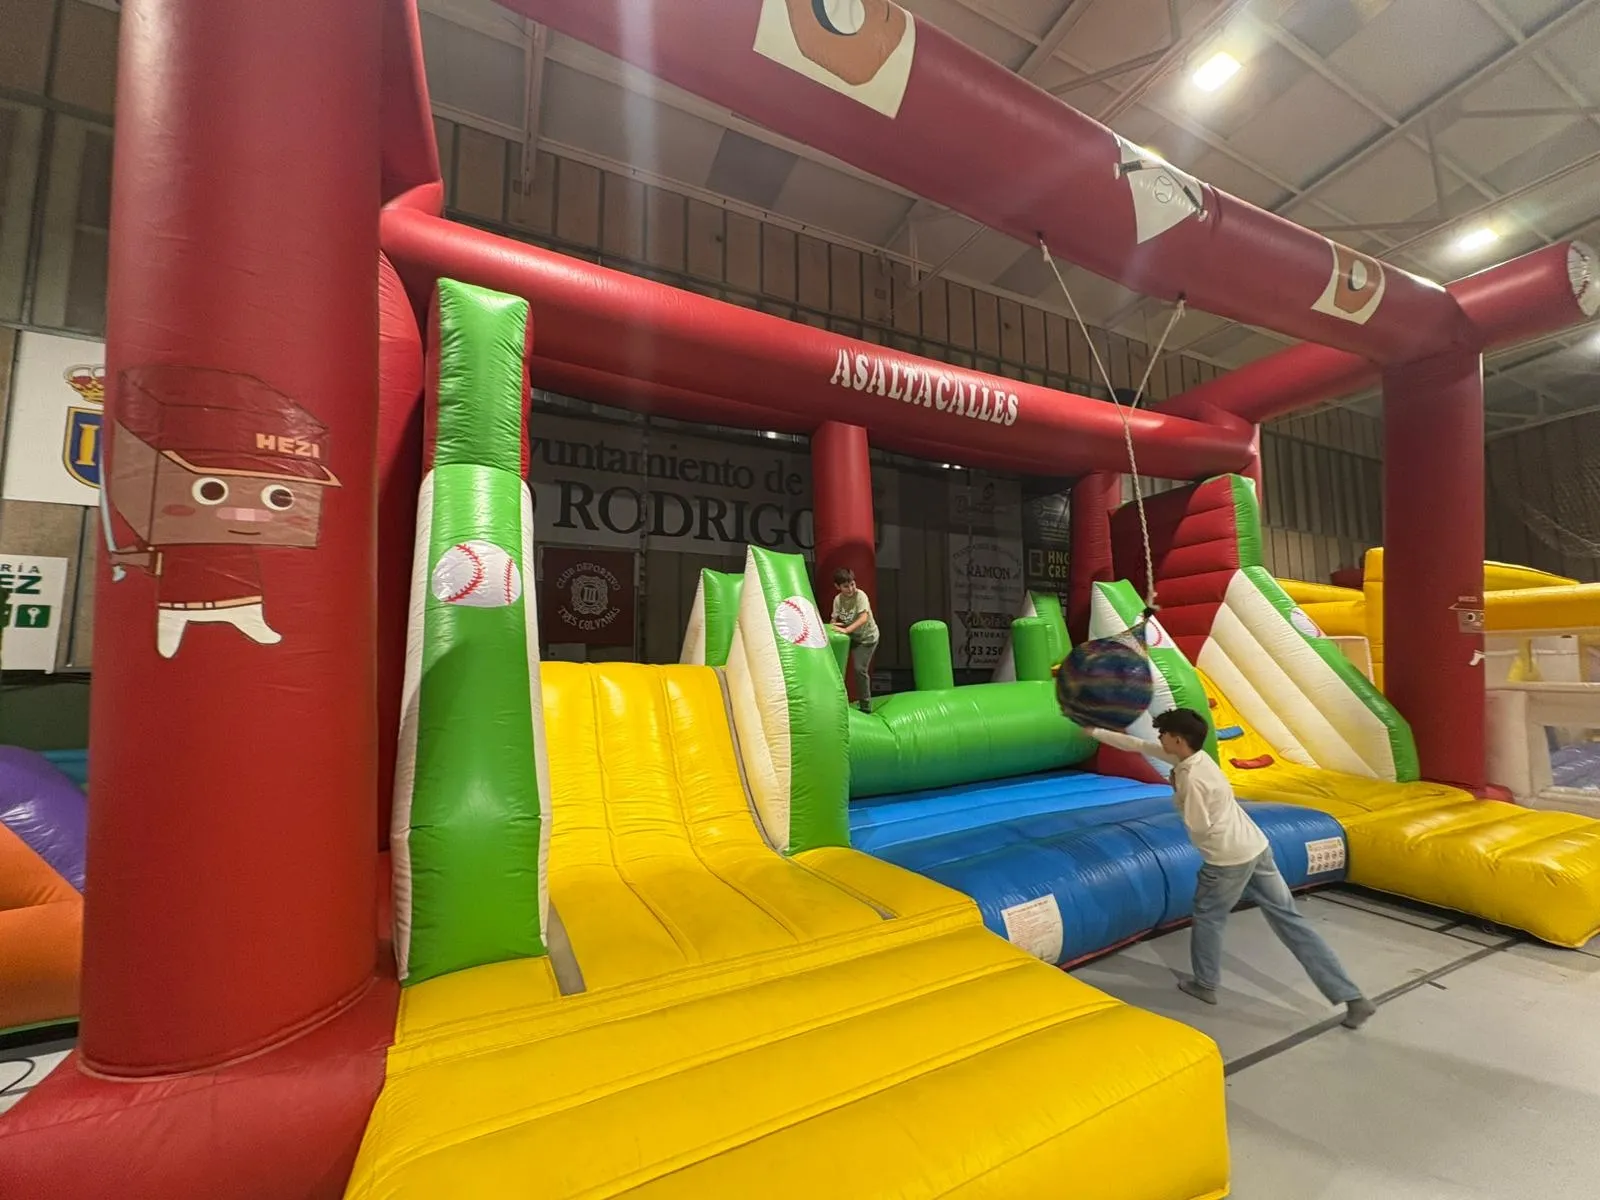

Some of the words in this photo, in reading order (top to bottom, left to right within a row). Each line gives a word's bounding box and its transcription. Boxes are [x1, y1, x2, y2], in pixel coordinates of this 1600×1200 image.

[830, 349, 1019, 426] ASALTACALLES
[256, 432, 320, 459] HEZI
[764, 459, 803, 496] de
[556, 567, 576, 589] CLUB
[576, 562, 621, 591] DEPORTIVO
[557, 605, 578, 627] TRES
